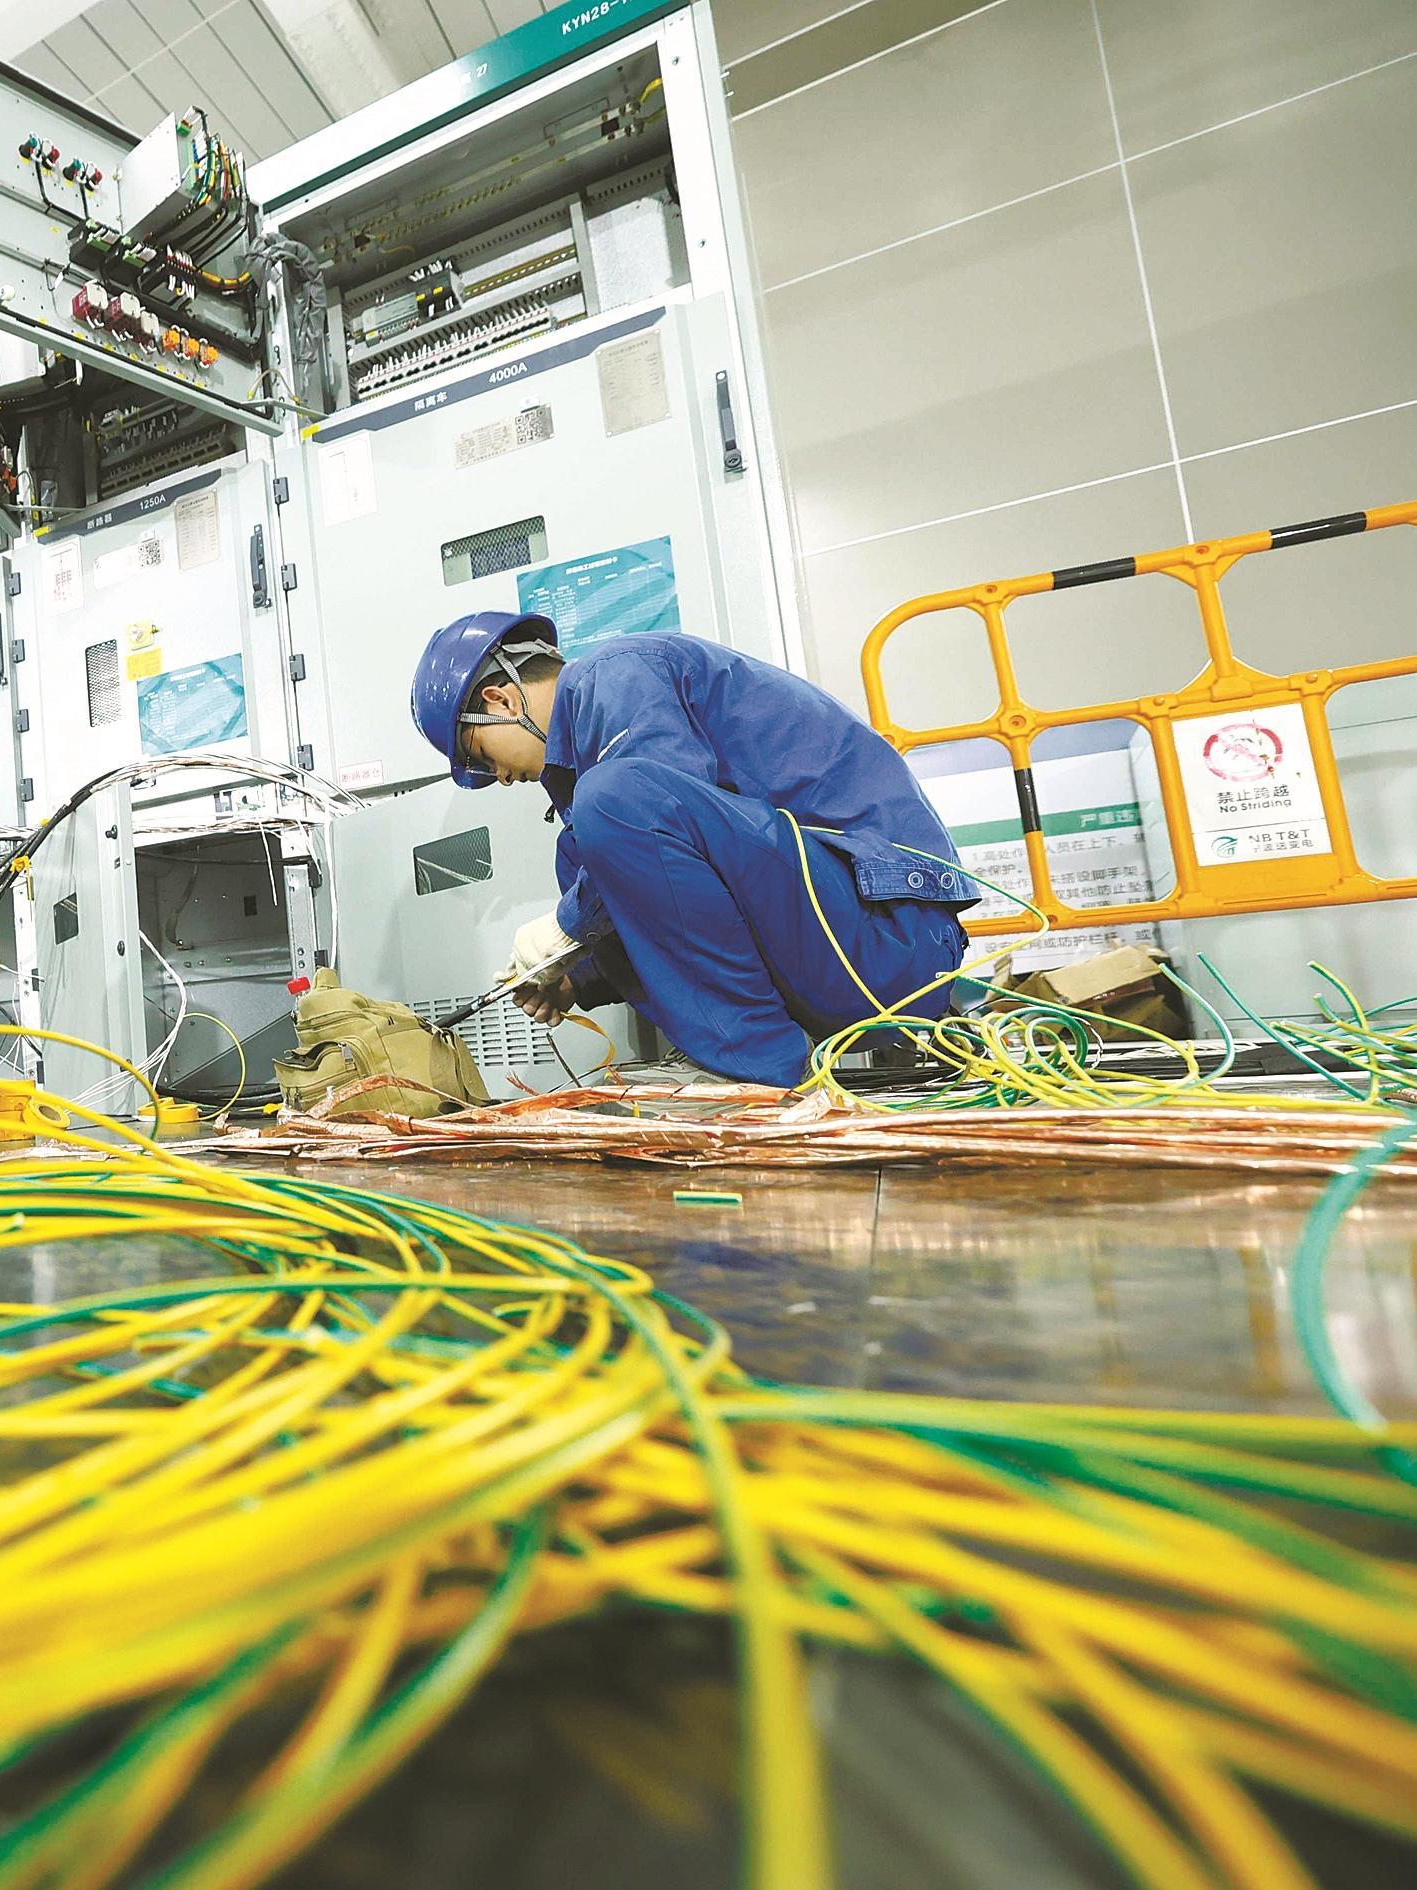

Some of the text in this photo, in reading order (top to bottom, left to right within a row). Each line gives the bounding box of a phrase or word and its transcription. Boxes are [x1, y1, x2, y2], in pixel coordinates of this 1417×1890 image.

[488, 362, 528, 384] 4000A
[139, 494, 167, 511] 1250A
[1216, 784, 1290, 805] 禁止跨越
[1220, 798, 1292, 813] No Striding
[1276, 829, 1311, 842] T&T
